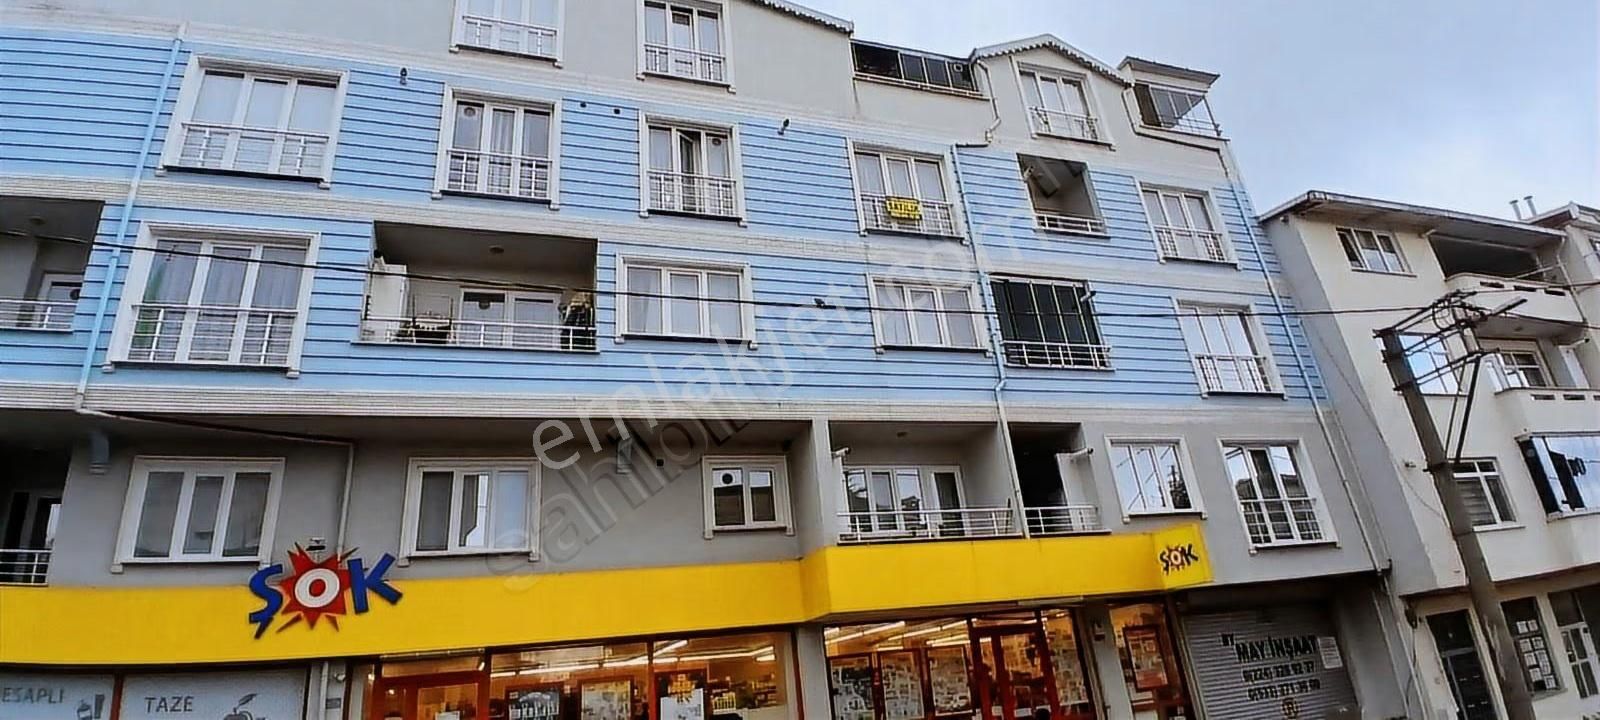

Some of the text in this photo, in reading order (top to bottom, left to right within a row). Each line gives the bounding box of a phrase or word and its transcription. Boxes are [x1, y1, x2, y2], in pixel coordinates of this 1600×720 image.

[1160, 543, 1199, 576] ŞOK
[249, 553, 403, 640] ŞOK
[145, 696, 194, 713] TAZE
